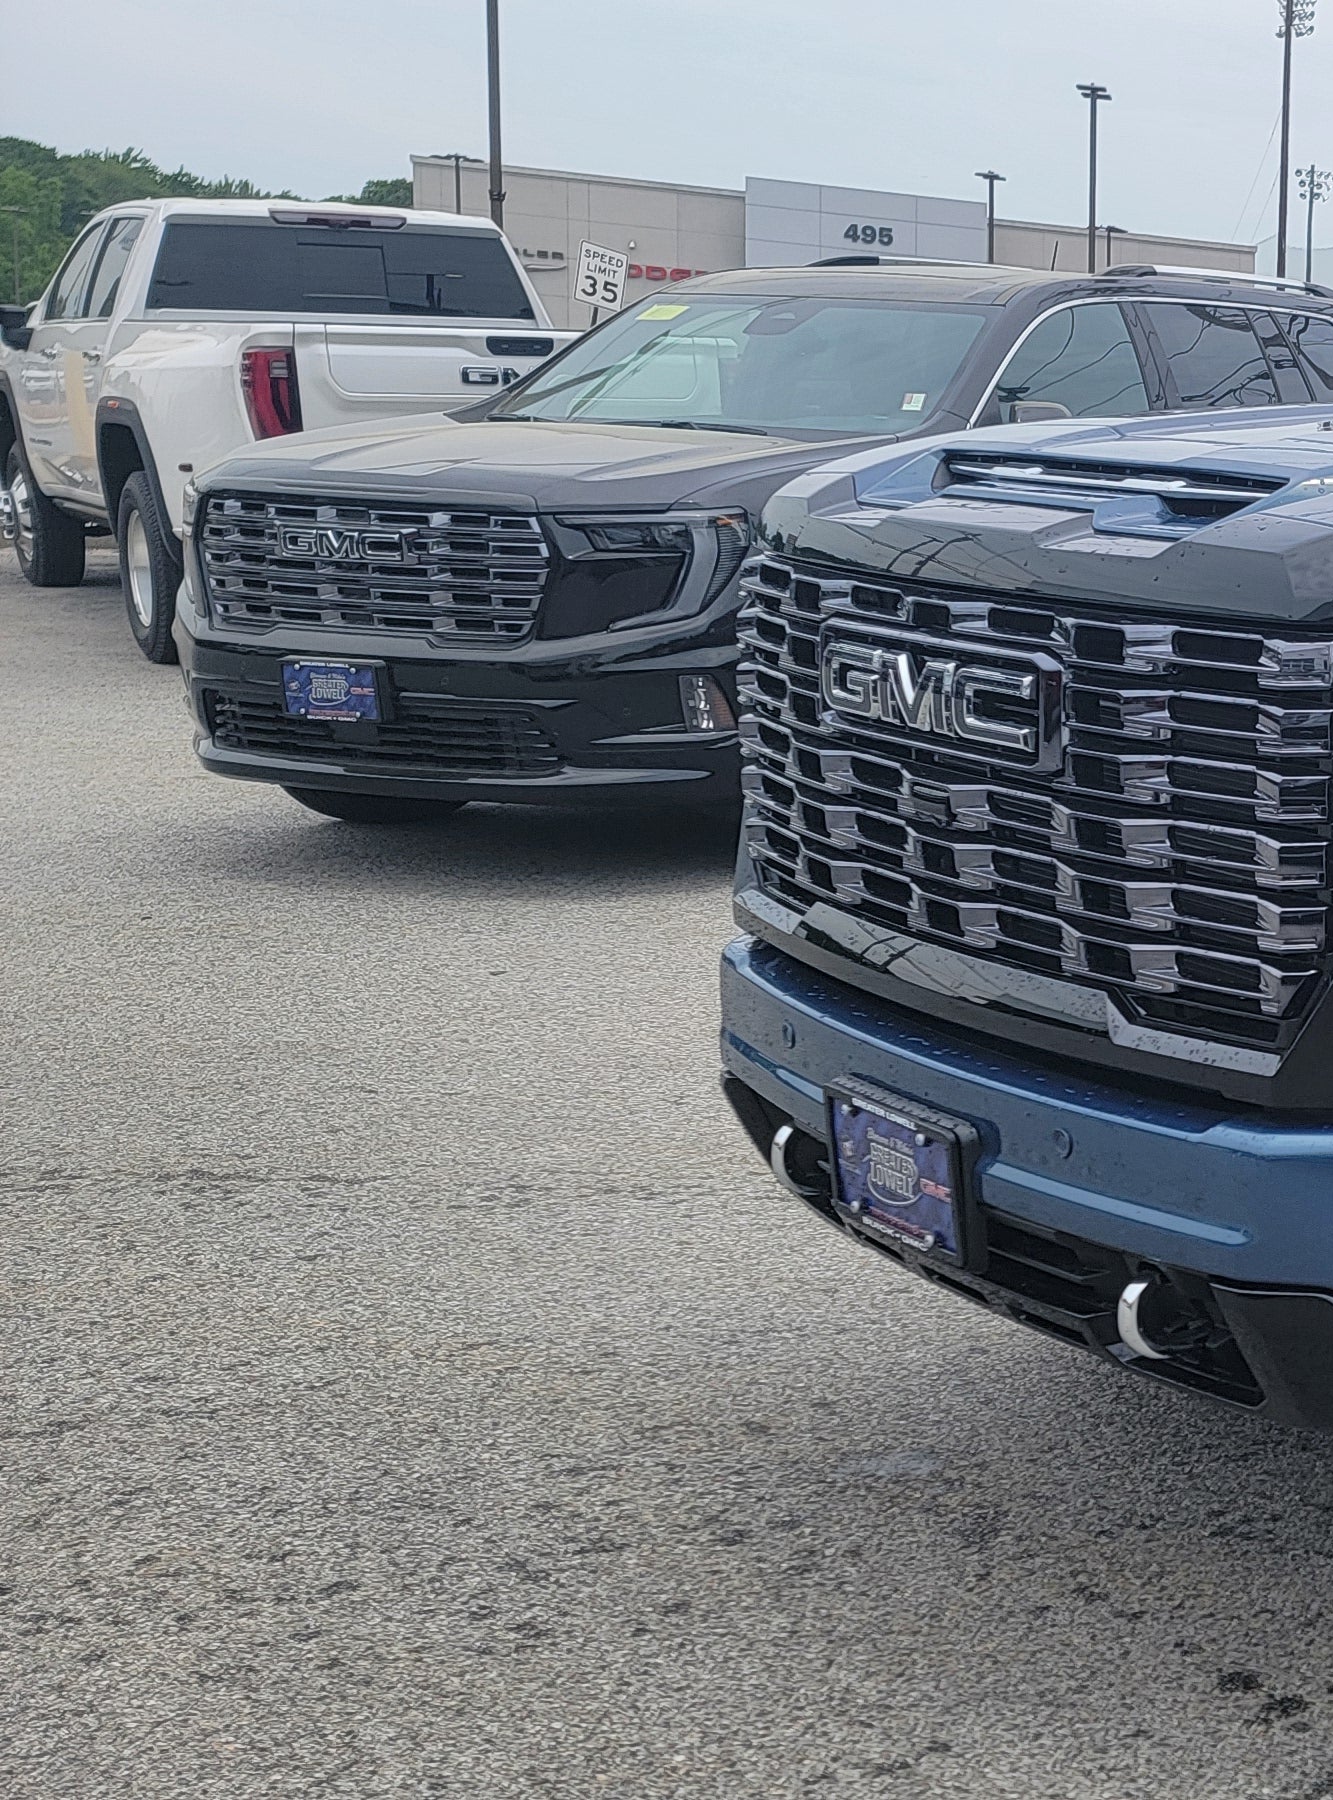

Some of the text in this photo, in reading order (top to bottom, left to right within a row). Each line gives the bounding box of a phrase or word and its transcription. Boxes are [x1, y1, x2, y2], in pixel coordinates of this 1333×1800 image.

[843, 223, 894, 247] 495
[584, 248, 624, 269] SPEED
[586, 262, 619, 280] LIMIT
[580, 275, 619, 304] 35
[281, 528, 403, 562] GMC
[311, 679, 347, 689] GREATER
[311, 688, 346, 700] LOWELL
[822, 642, 1037, 753] GMC
[886, 1112, 918, 1131] LOWELL
[869, 1142, 917, 1178] GREATER
[869, 1161, 915, 1200] LOWELL
[919, 1177, 952, 1204] GMC
[862, 1215, 895, 1238] BUICK
[902, 1236, 929, 1252] GMC
